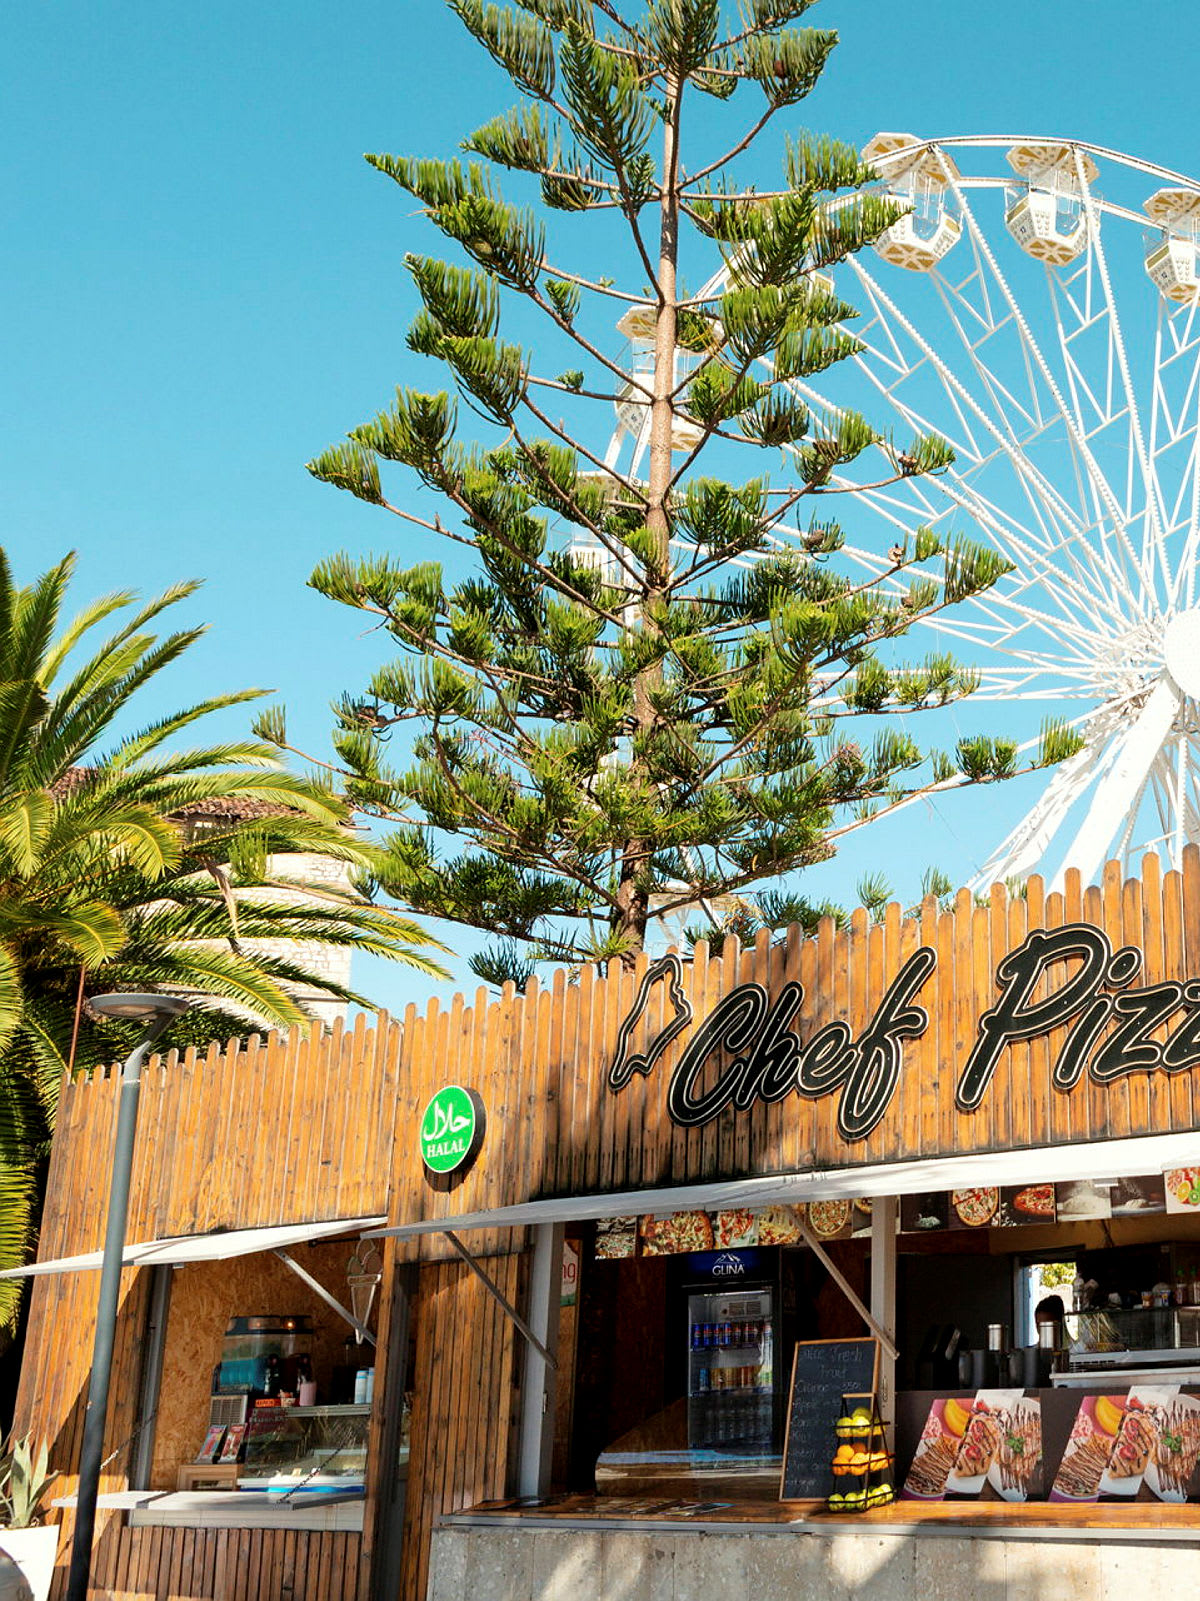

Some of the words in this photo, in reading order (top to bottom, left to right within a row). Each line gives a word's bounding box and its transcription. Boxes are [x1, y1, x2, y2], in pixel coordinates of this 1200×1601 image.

[668, 946, 938, 1140] Chef
[423, 1100, 470, 1141] حلال
[427, 1139, 465, 1158] HALAL
[712, 1264, 745, 1276] GLINA
